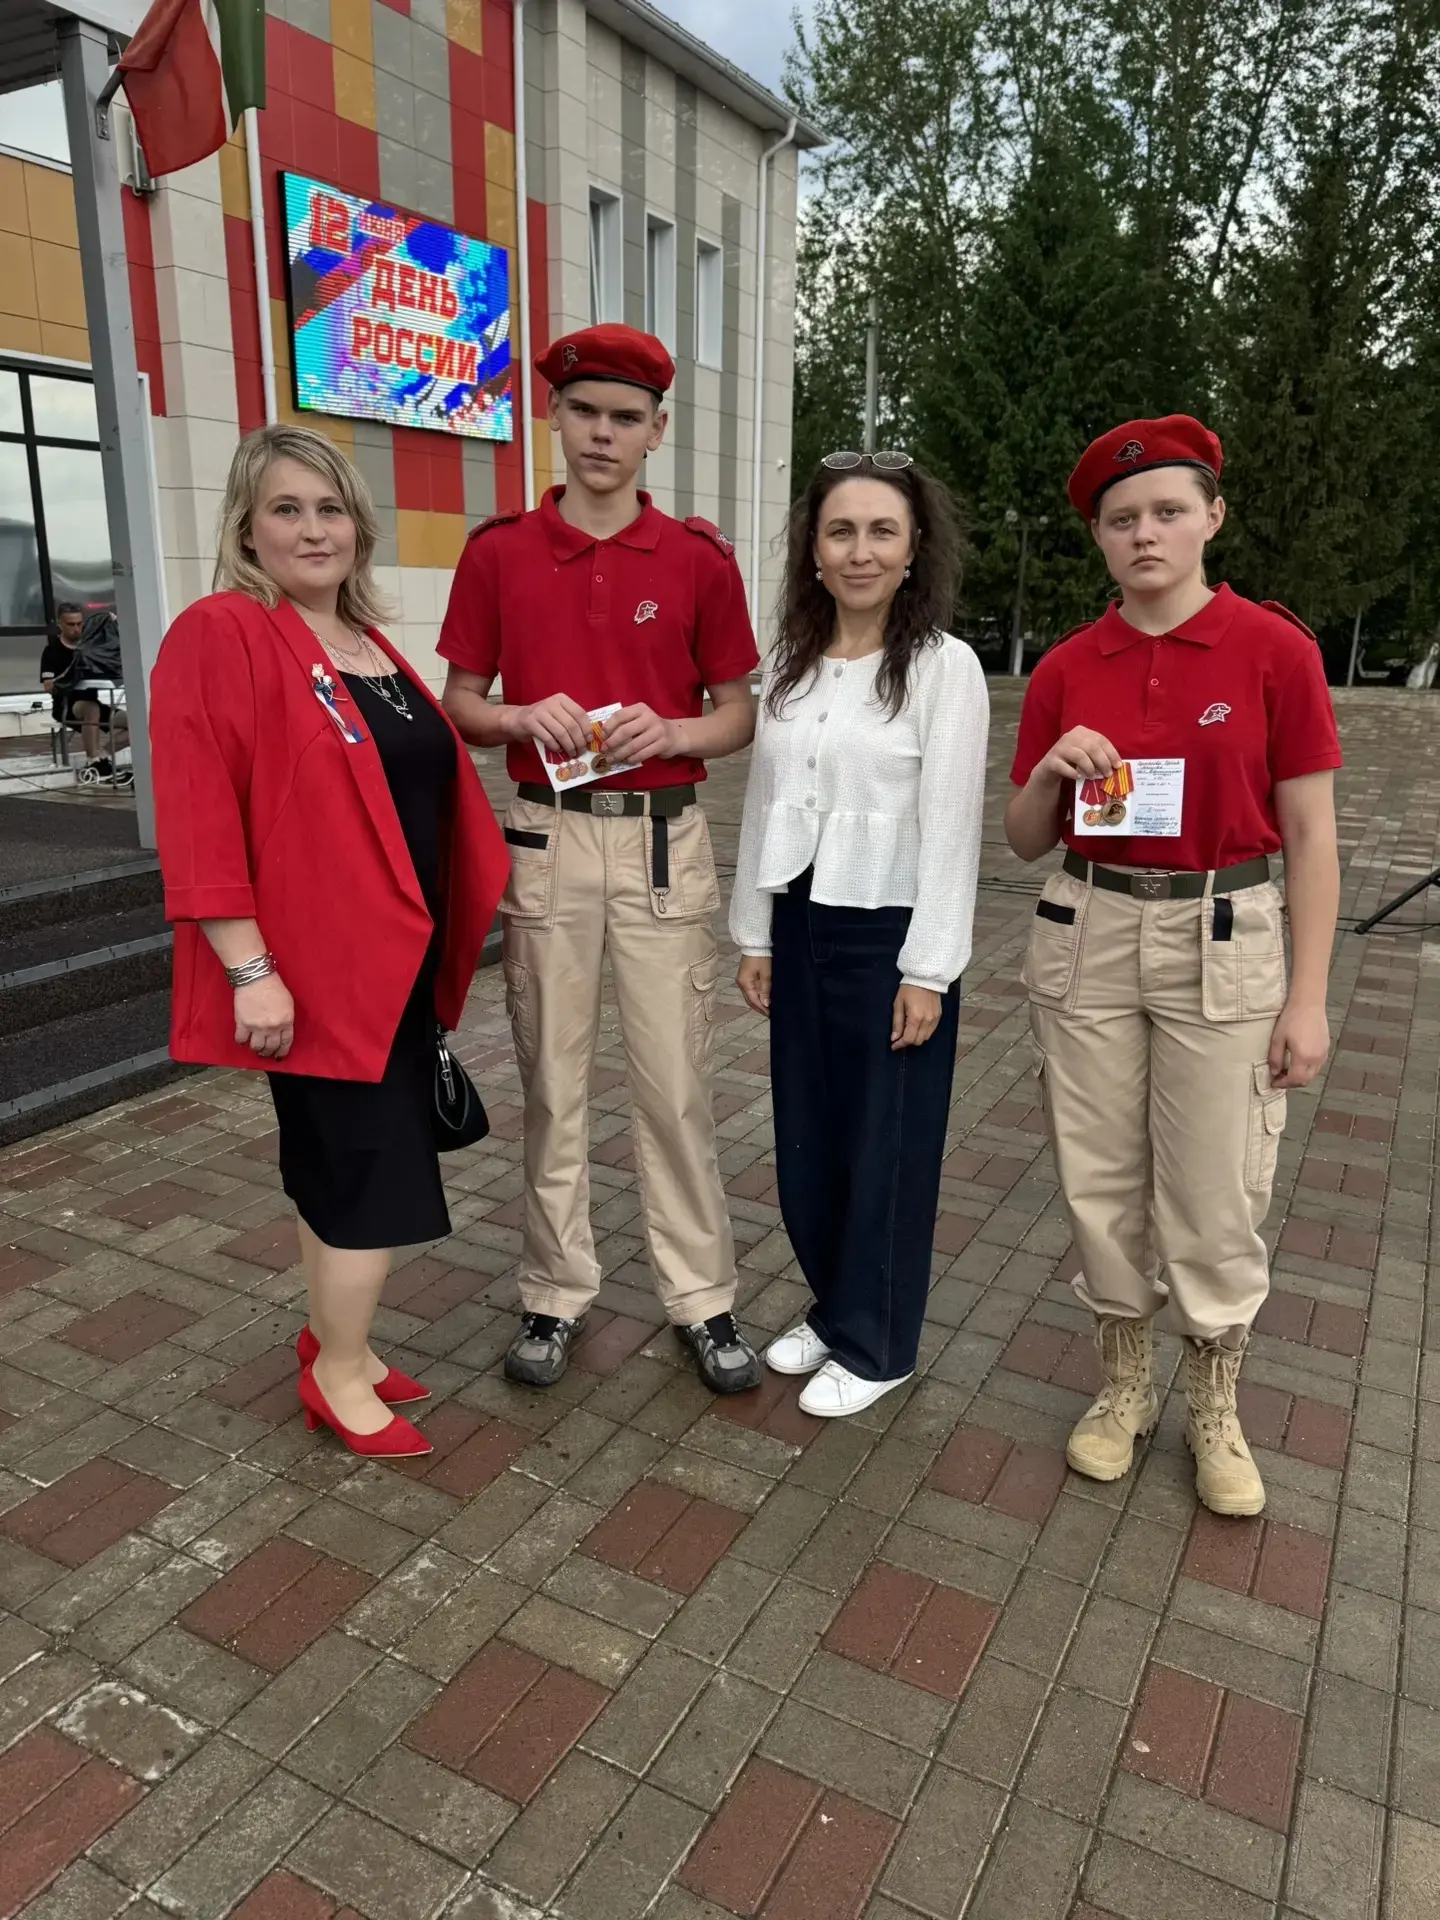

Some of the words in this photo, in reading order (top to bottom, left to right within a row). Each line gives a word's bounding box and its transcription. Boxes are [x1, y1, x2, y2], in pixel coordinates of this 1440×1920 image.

[309, 194, 350, 255] 12
[371, 259, 459, 320] ДЕНЬ
[350, 315, 480, 384] РОССИИ
